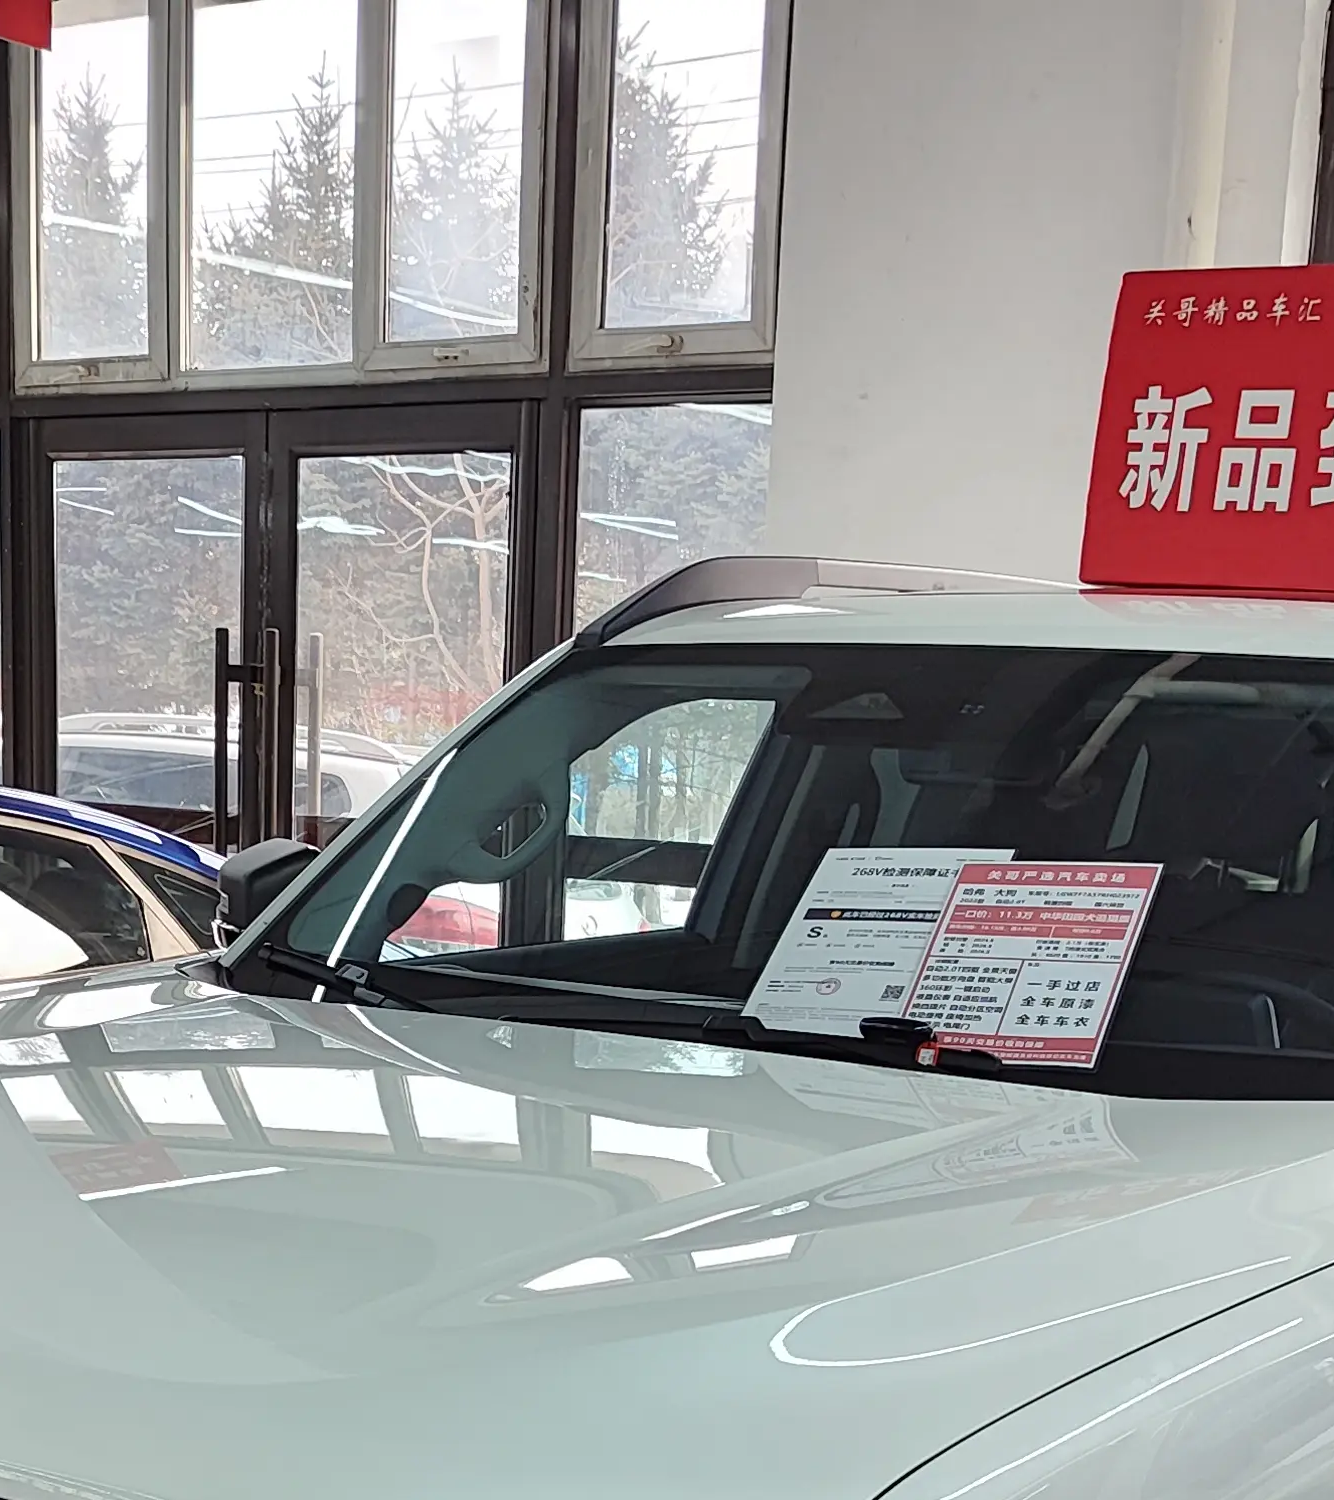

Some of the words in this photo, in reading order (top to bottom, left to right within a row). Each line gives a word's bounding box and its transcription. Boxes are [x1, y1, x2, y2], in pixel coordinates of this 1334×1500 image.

[1143, 293, 1322, 327] 关哥精品车汇
[1027, 979, 1102, 992] 一手过店
[1020, 995, 1097, 1010] 全车原漆
[1014, 1013, 1091, 1028] 全车车衣
